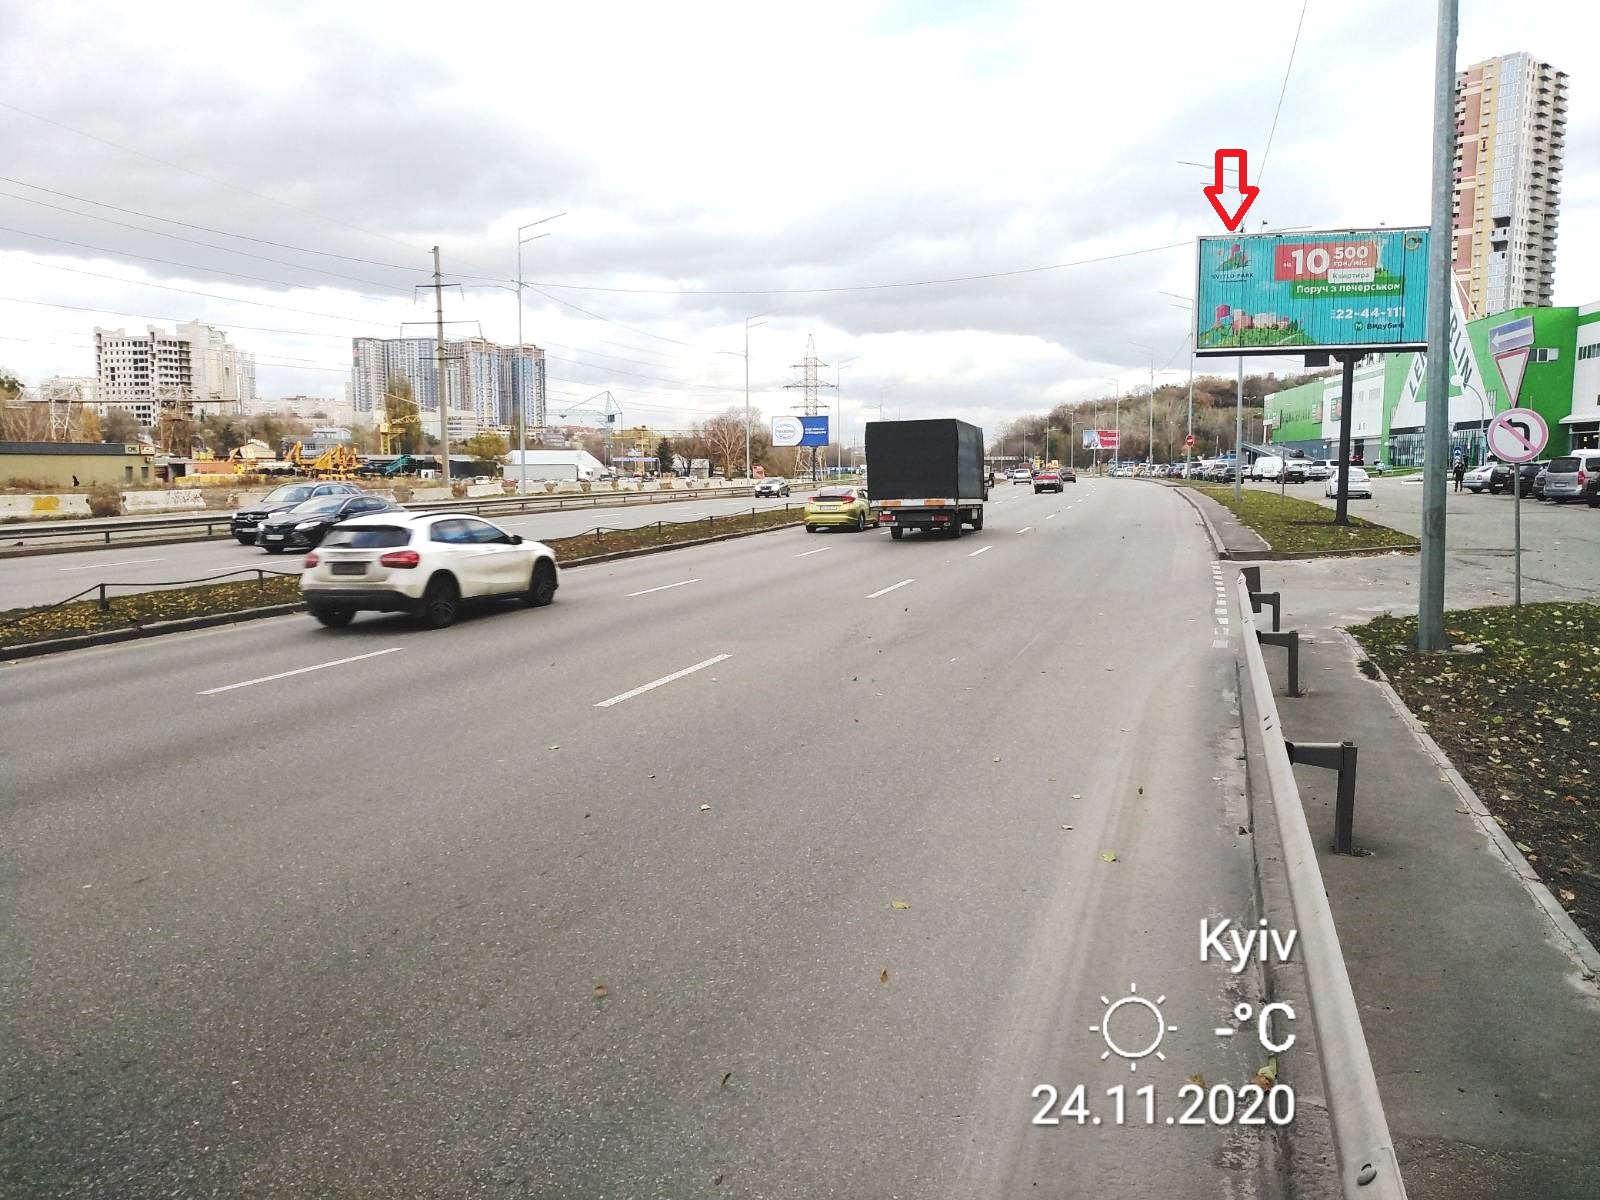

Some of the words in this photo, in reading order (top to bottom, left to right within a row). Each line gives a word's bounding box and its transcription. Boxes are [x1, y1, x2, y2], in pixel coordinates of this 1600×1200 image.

[1333, 246, 1369, 260] 500
[1291, 248, 1330, 275] 10
[1332, 272, 1370, 280] Квартира
[1296, 285, 1329, 294] Поруч
[1339, 283, 1401, 293] печерськом
